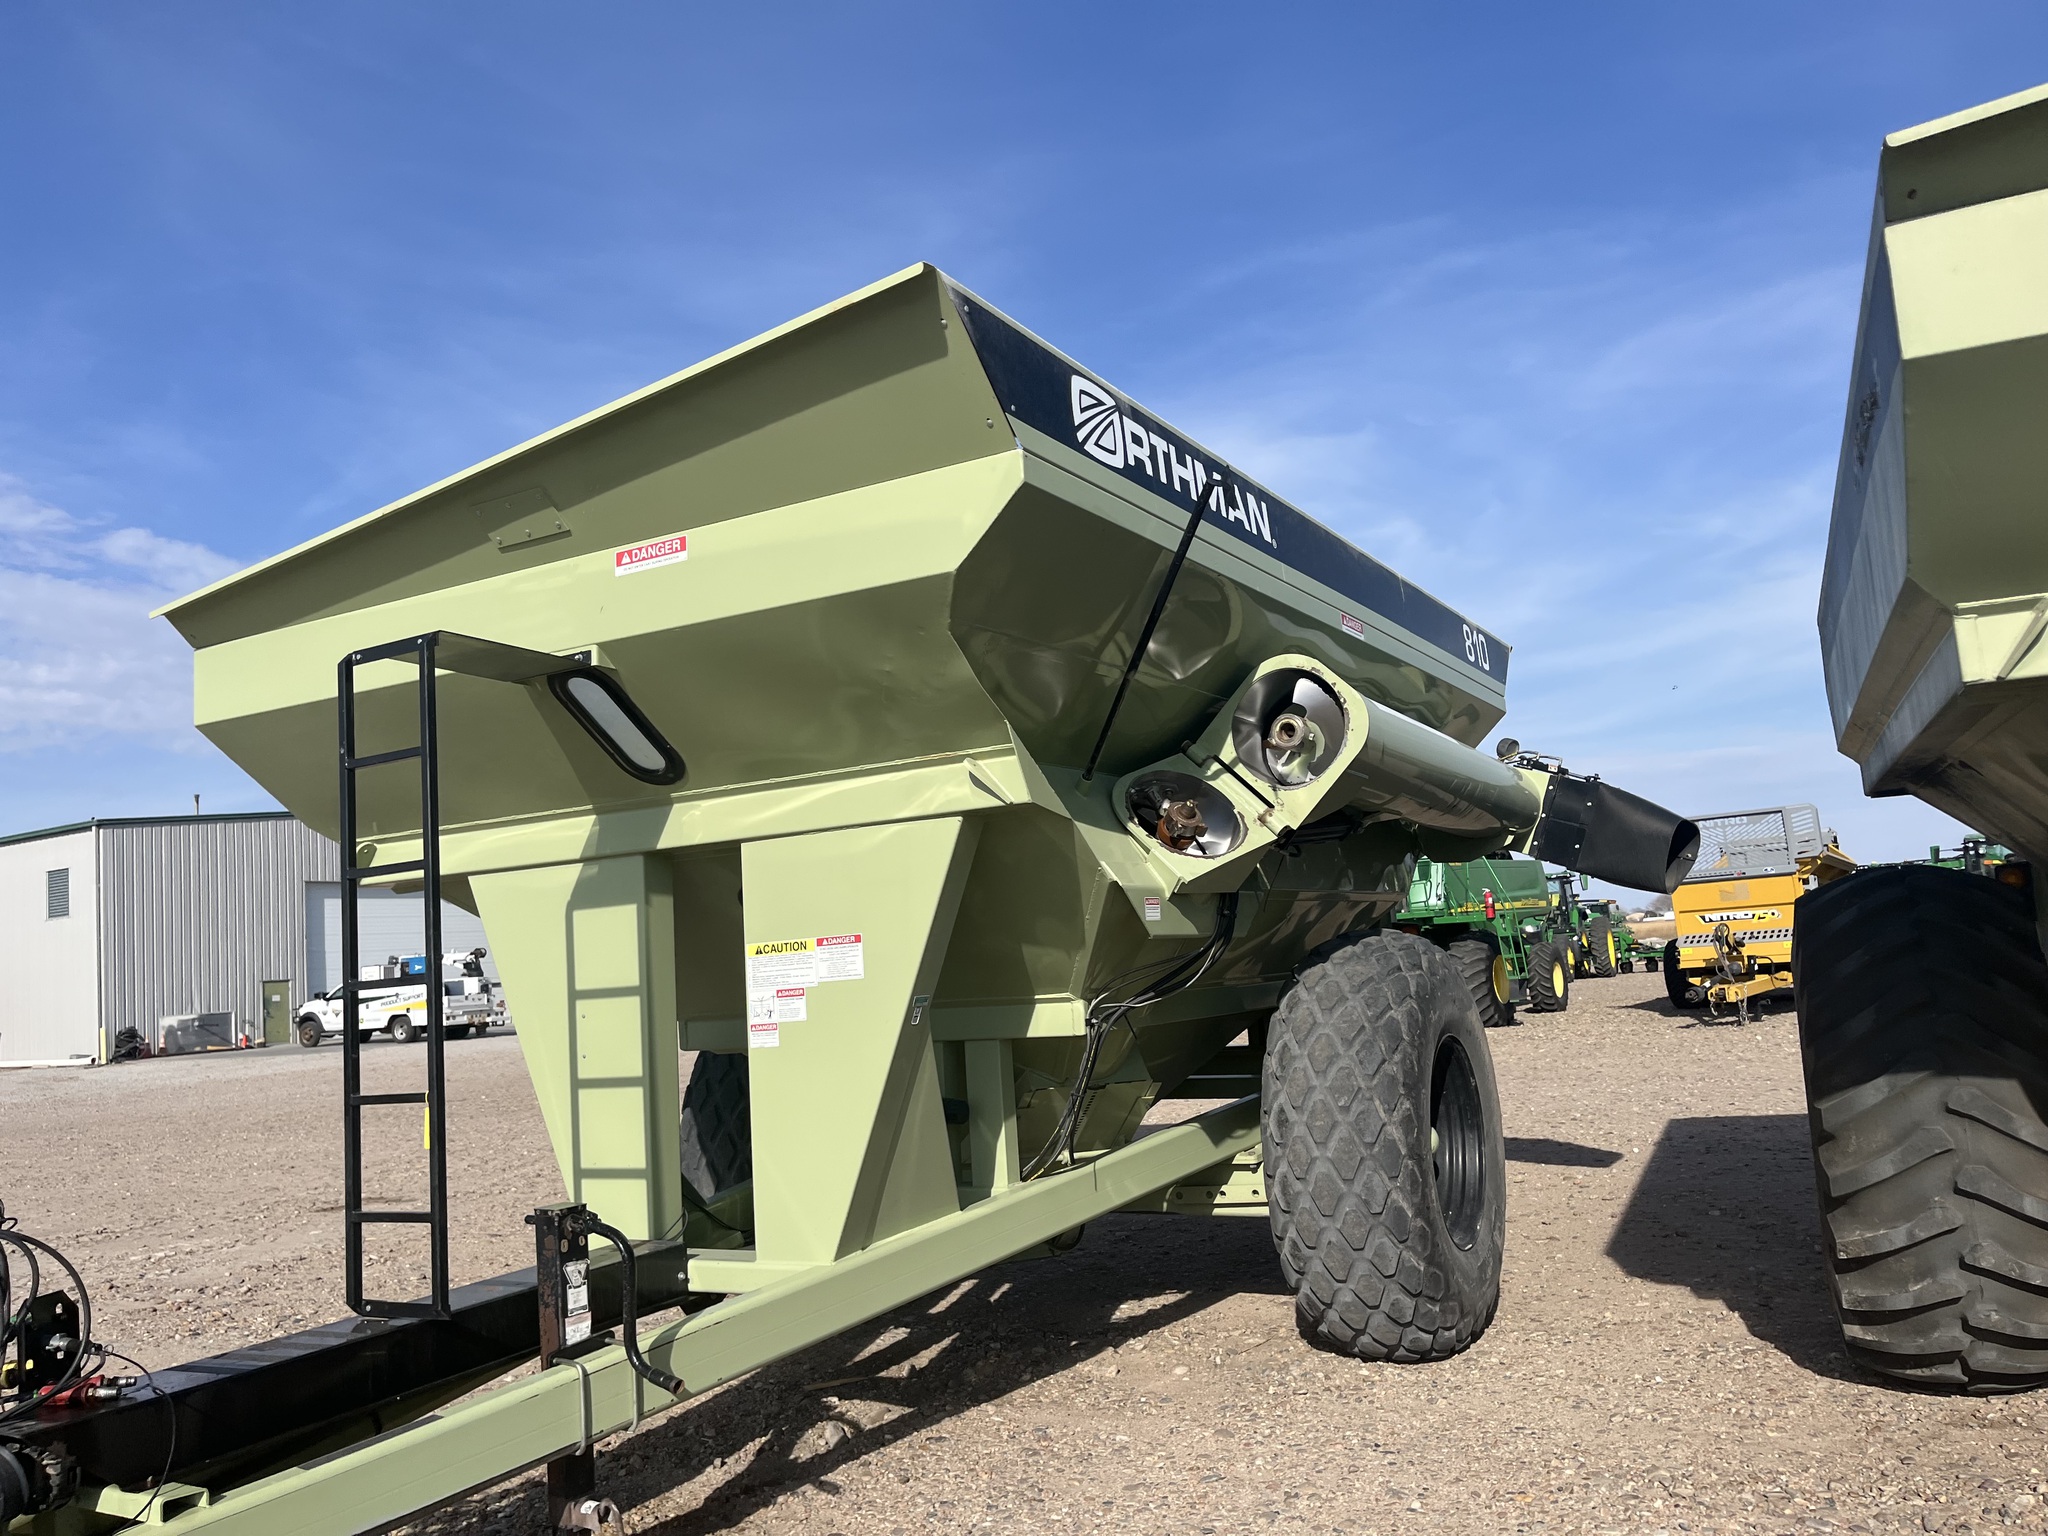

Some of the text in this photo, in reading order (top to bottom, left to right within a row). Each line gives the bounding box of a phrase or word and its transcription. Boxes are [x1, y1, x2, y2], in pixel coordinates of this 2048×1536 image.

[632, 539, 680, 562] DANGER
[1462, 623, 1490, 671] 810
[1698, 816, 1747, 828] NITRO
[1704, 911, 1753, 922] NITRO
[828, 936, 855, 944] DANGER
[763, 941, 807, 954] CAUTION
[781, 989, 804, 997] DANGER
[380, 992, 424, 1007] PRODUCT SUPPORT
